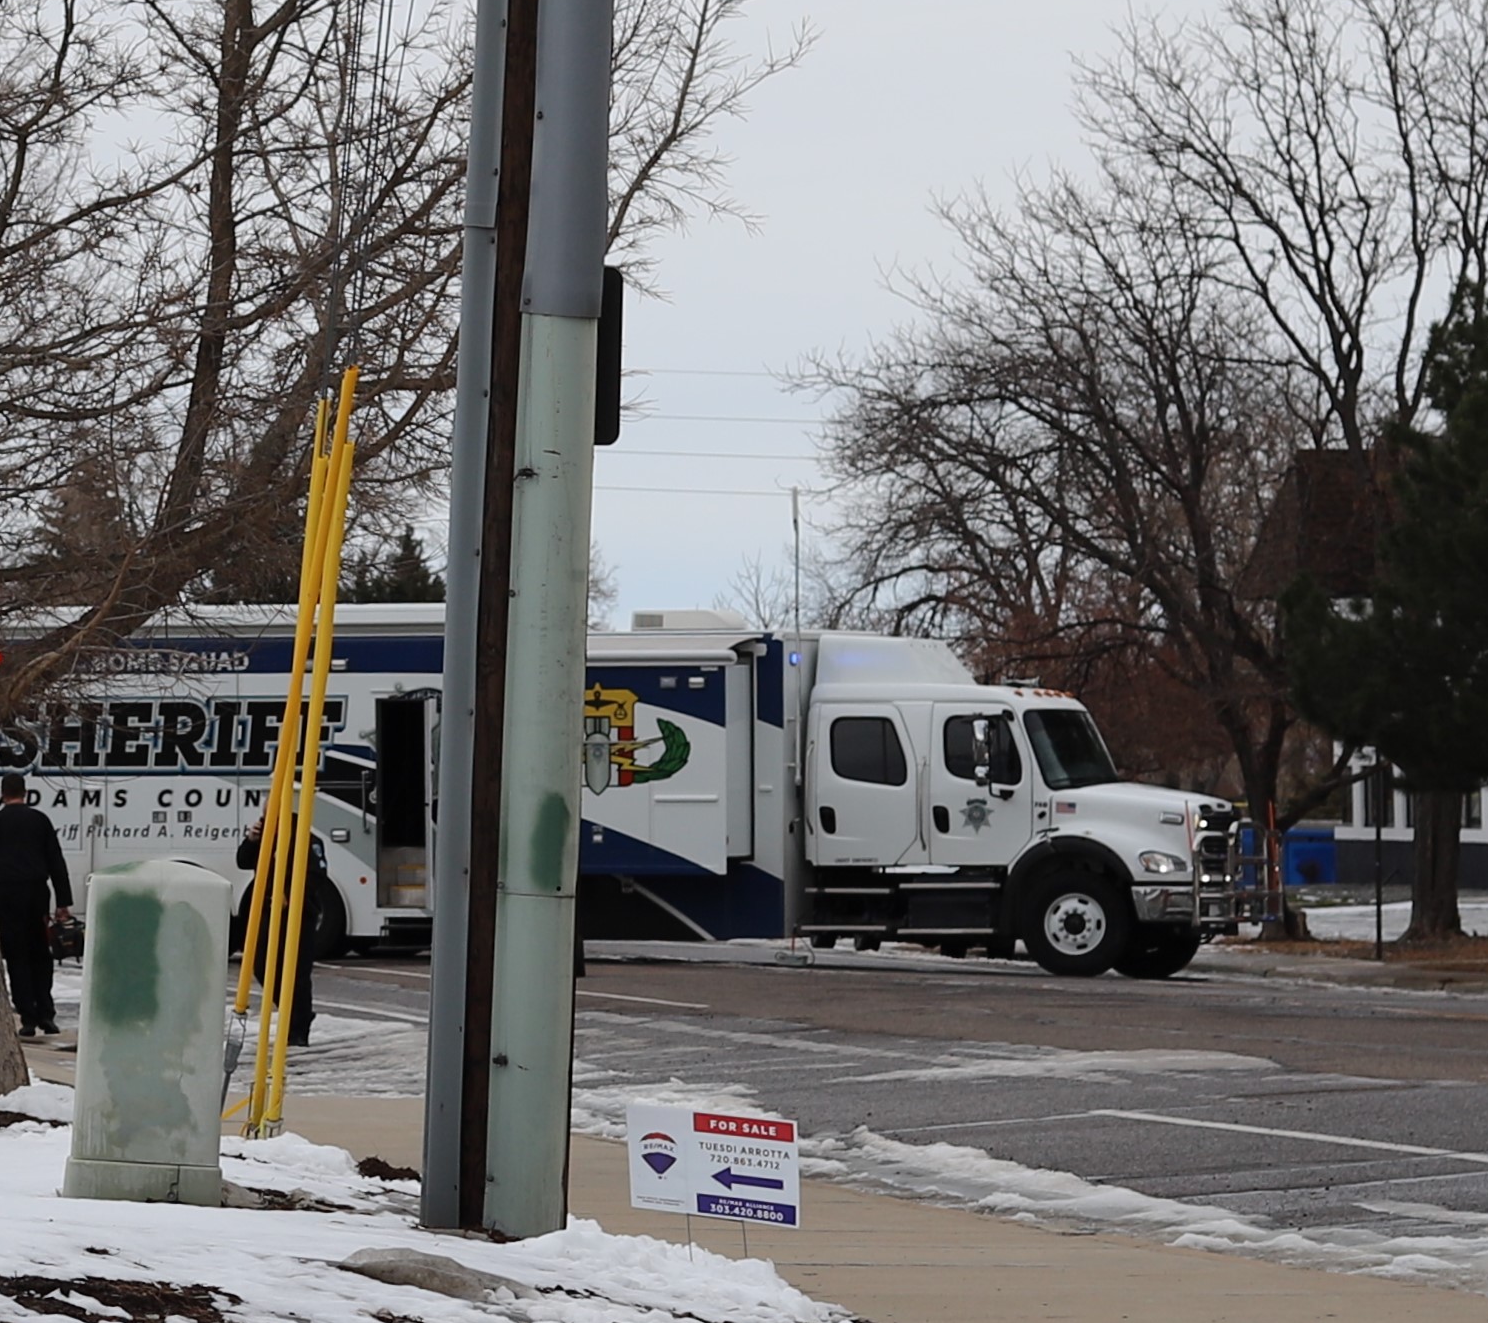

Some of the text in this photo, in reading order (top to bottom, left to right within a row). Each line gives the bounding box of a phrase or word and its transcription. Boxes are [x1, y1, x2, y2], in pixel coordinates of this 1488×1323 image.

[170, 651, 250, 672] SQUAD
[157, 788, 262, 808] COUN
[86, 824, 151, 838] Richard
[157, 824, 174, 838] A.
[709, 1119, 777, 1137] FOR SALE
[643, 1143, 675, 1152] RE/MAX
[699, 1141, 790, 1160] TUESDI ARROTTA
[709, 1203, 784, 1221] 303.420.8800
